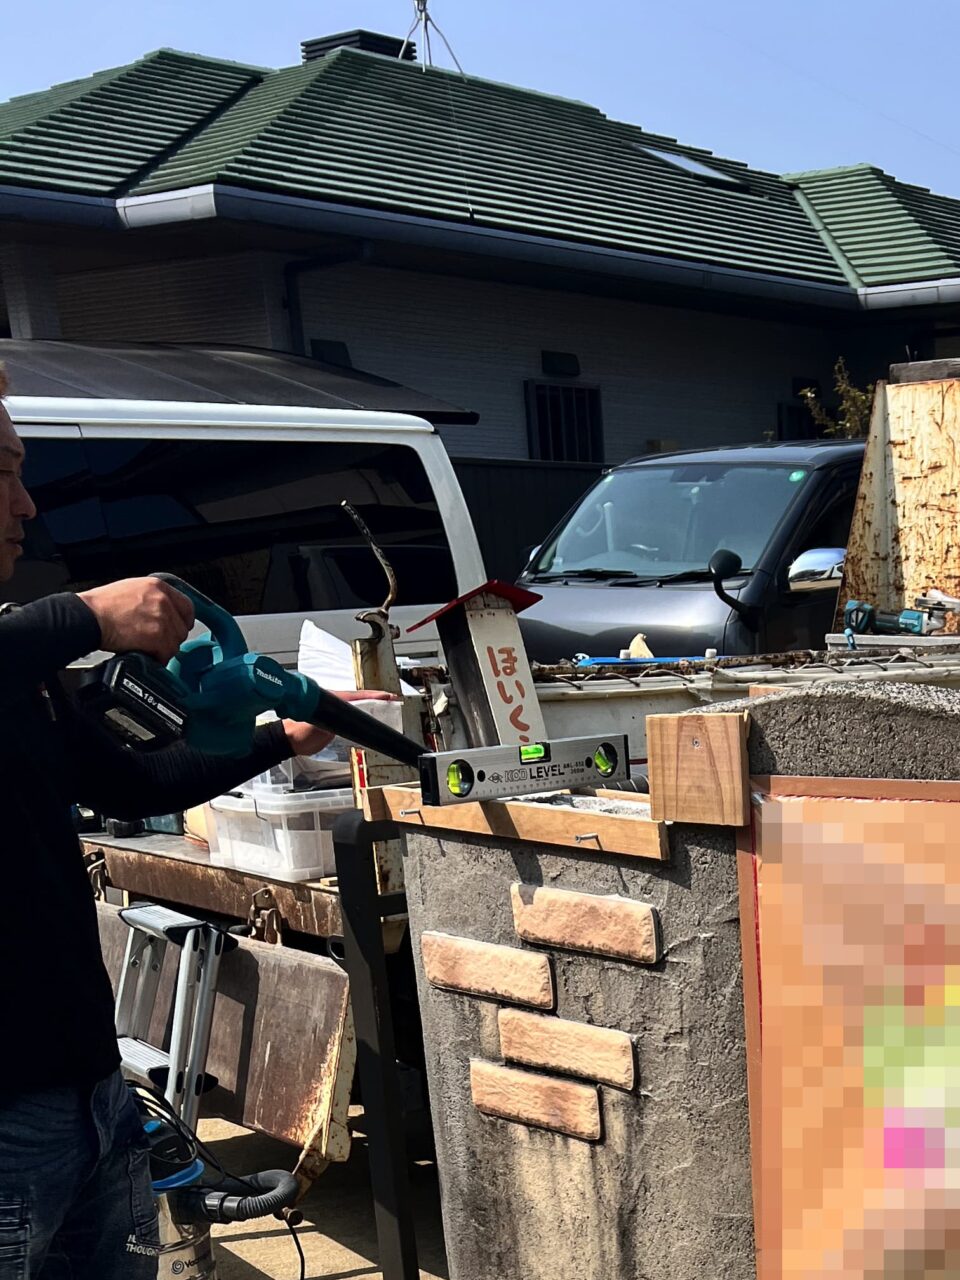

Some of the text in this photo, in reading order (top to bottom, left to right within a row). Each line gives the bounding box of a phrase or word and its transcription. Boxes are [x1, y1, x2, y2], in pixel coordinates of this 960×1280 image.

[486, 646, 531, 743] ほいく
[529, 763, 565, 780] LEVEL
